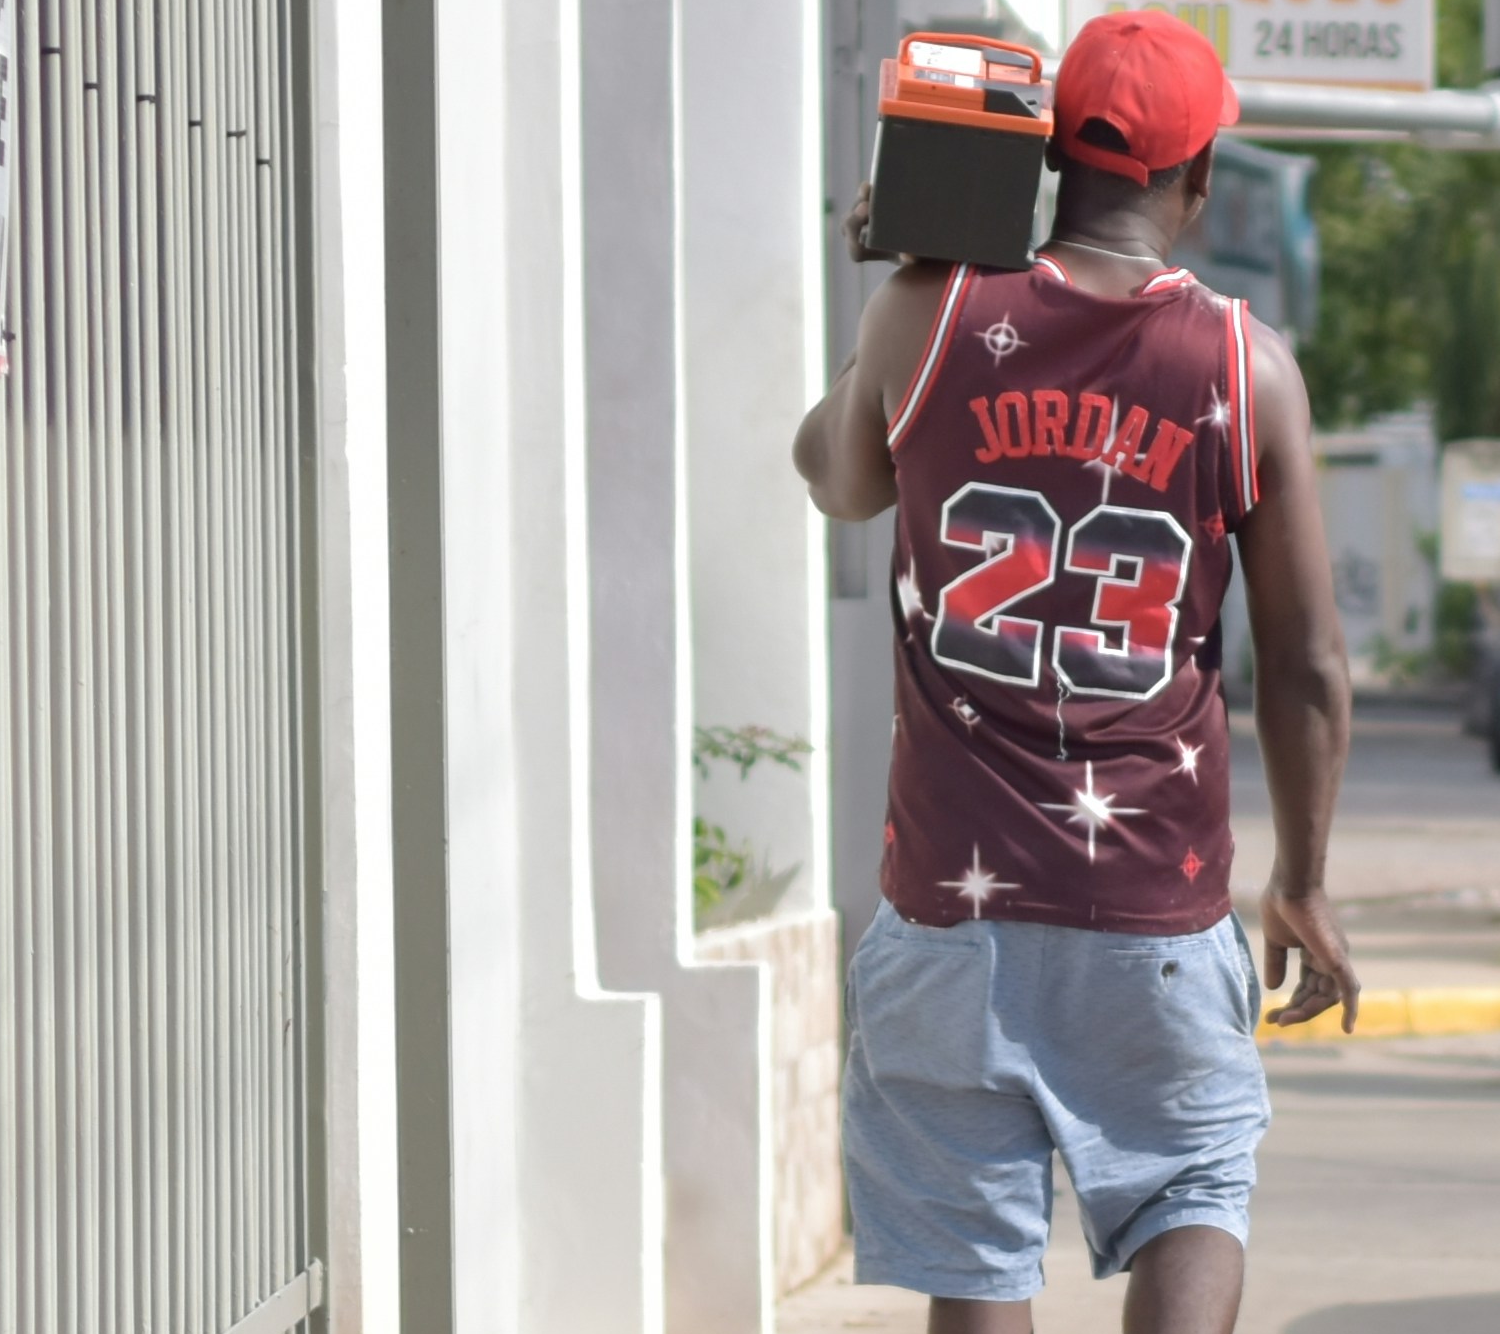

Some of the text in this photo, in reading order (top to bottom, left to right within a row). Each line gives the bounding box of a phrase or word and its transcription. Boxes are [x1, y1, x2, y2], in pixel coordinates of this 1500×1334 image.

[1255, 19, 1296, 58] 24
[1302, 20, 1404, 60] HORAS
[969, 389, 1195, 493] JORDAN
[931, 481, 1192, 701] 23
